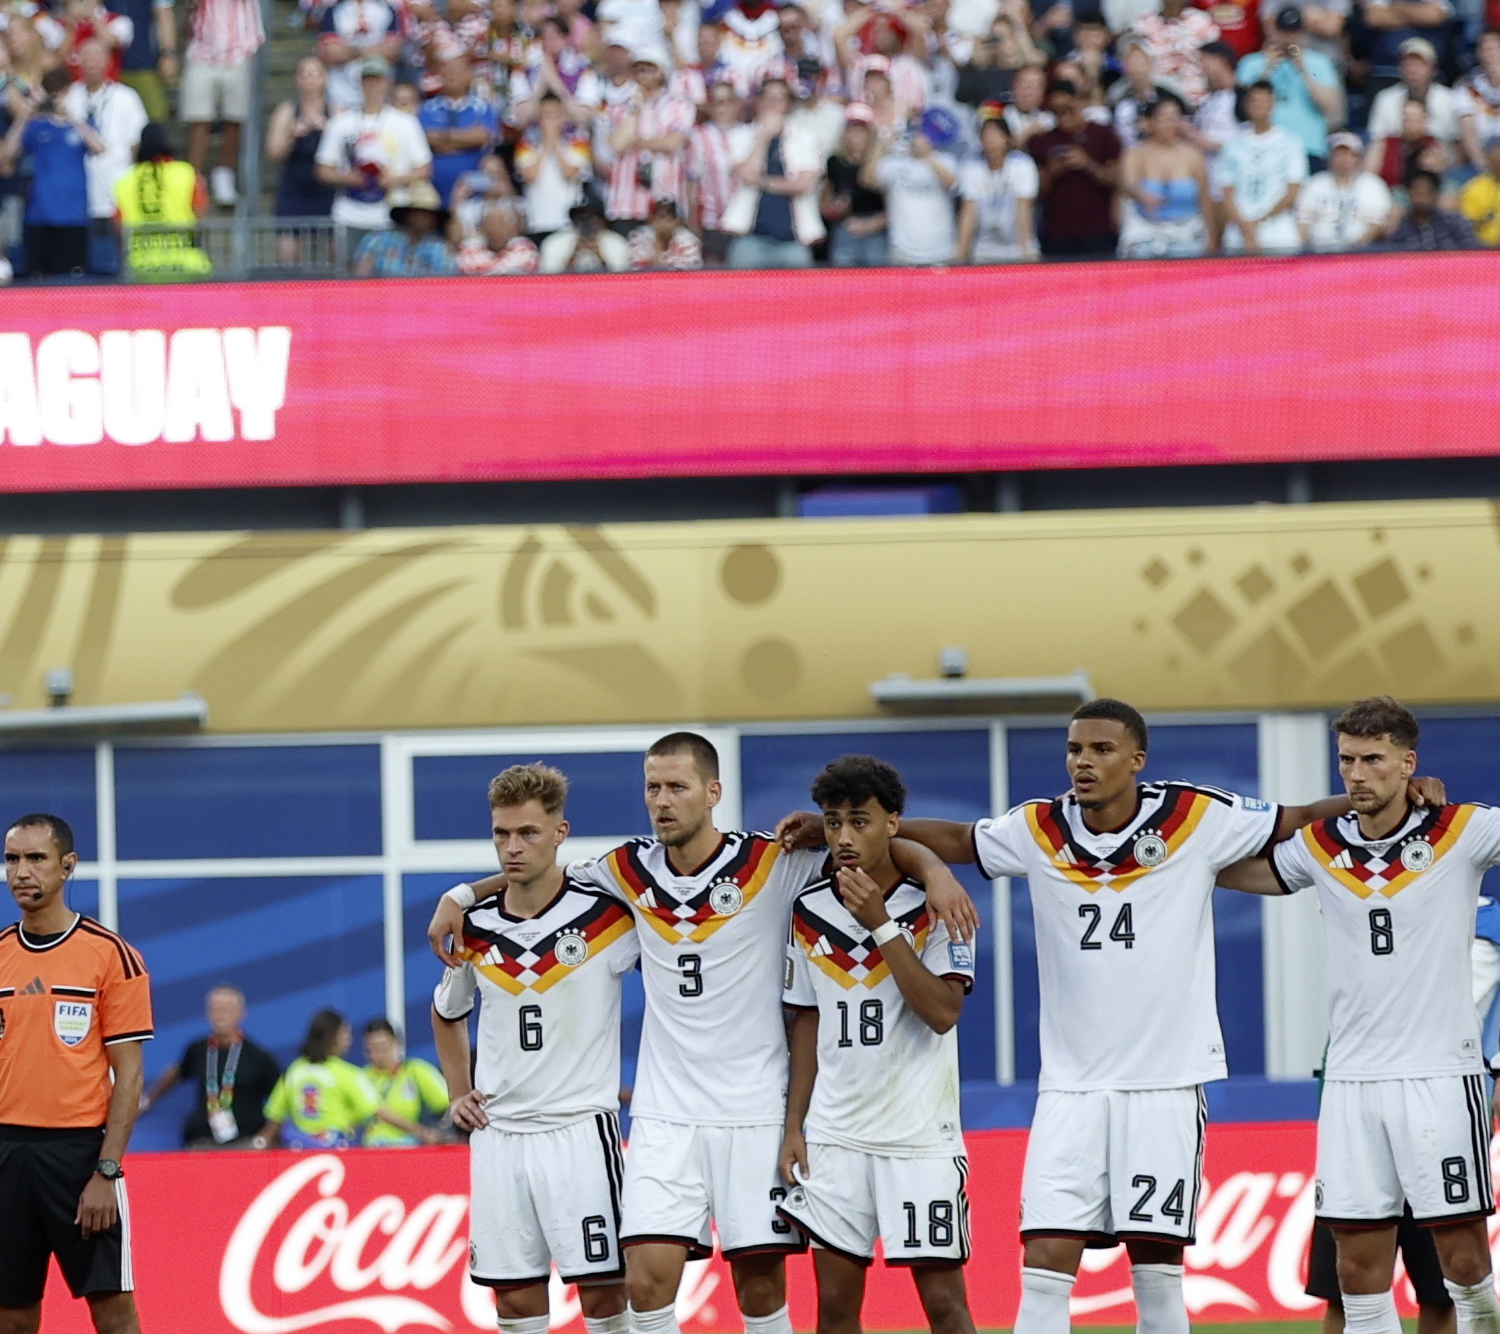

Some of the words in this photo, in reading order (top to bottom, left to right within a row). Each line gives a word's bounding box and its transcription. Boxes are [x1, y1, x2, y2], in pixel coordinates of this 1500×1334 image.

[1078, 902, 1136, 950] 24
[1369, 908, 1395, 956] 8
[678, 954, 704, 998] 3
[59, 1004, 87, 1017] FIFA
[518, 1004, 543, 1052] 6
[836, 999, 885, 1048] 18
[1129, 1174, 1185, 1226] 24
[1441, 1155, 1470, 1205] 8
[582, 1214, 609, 1264] 6
[903, 1199, 954, 1249] 18
